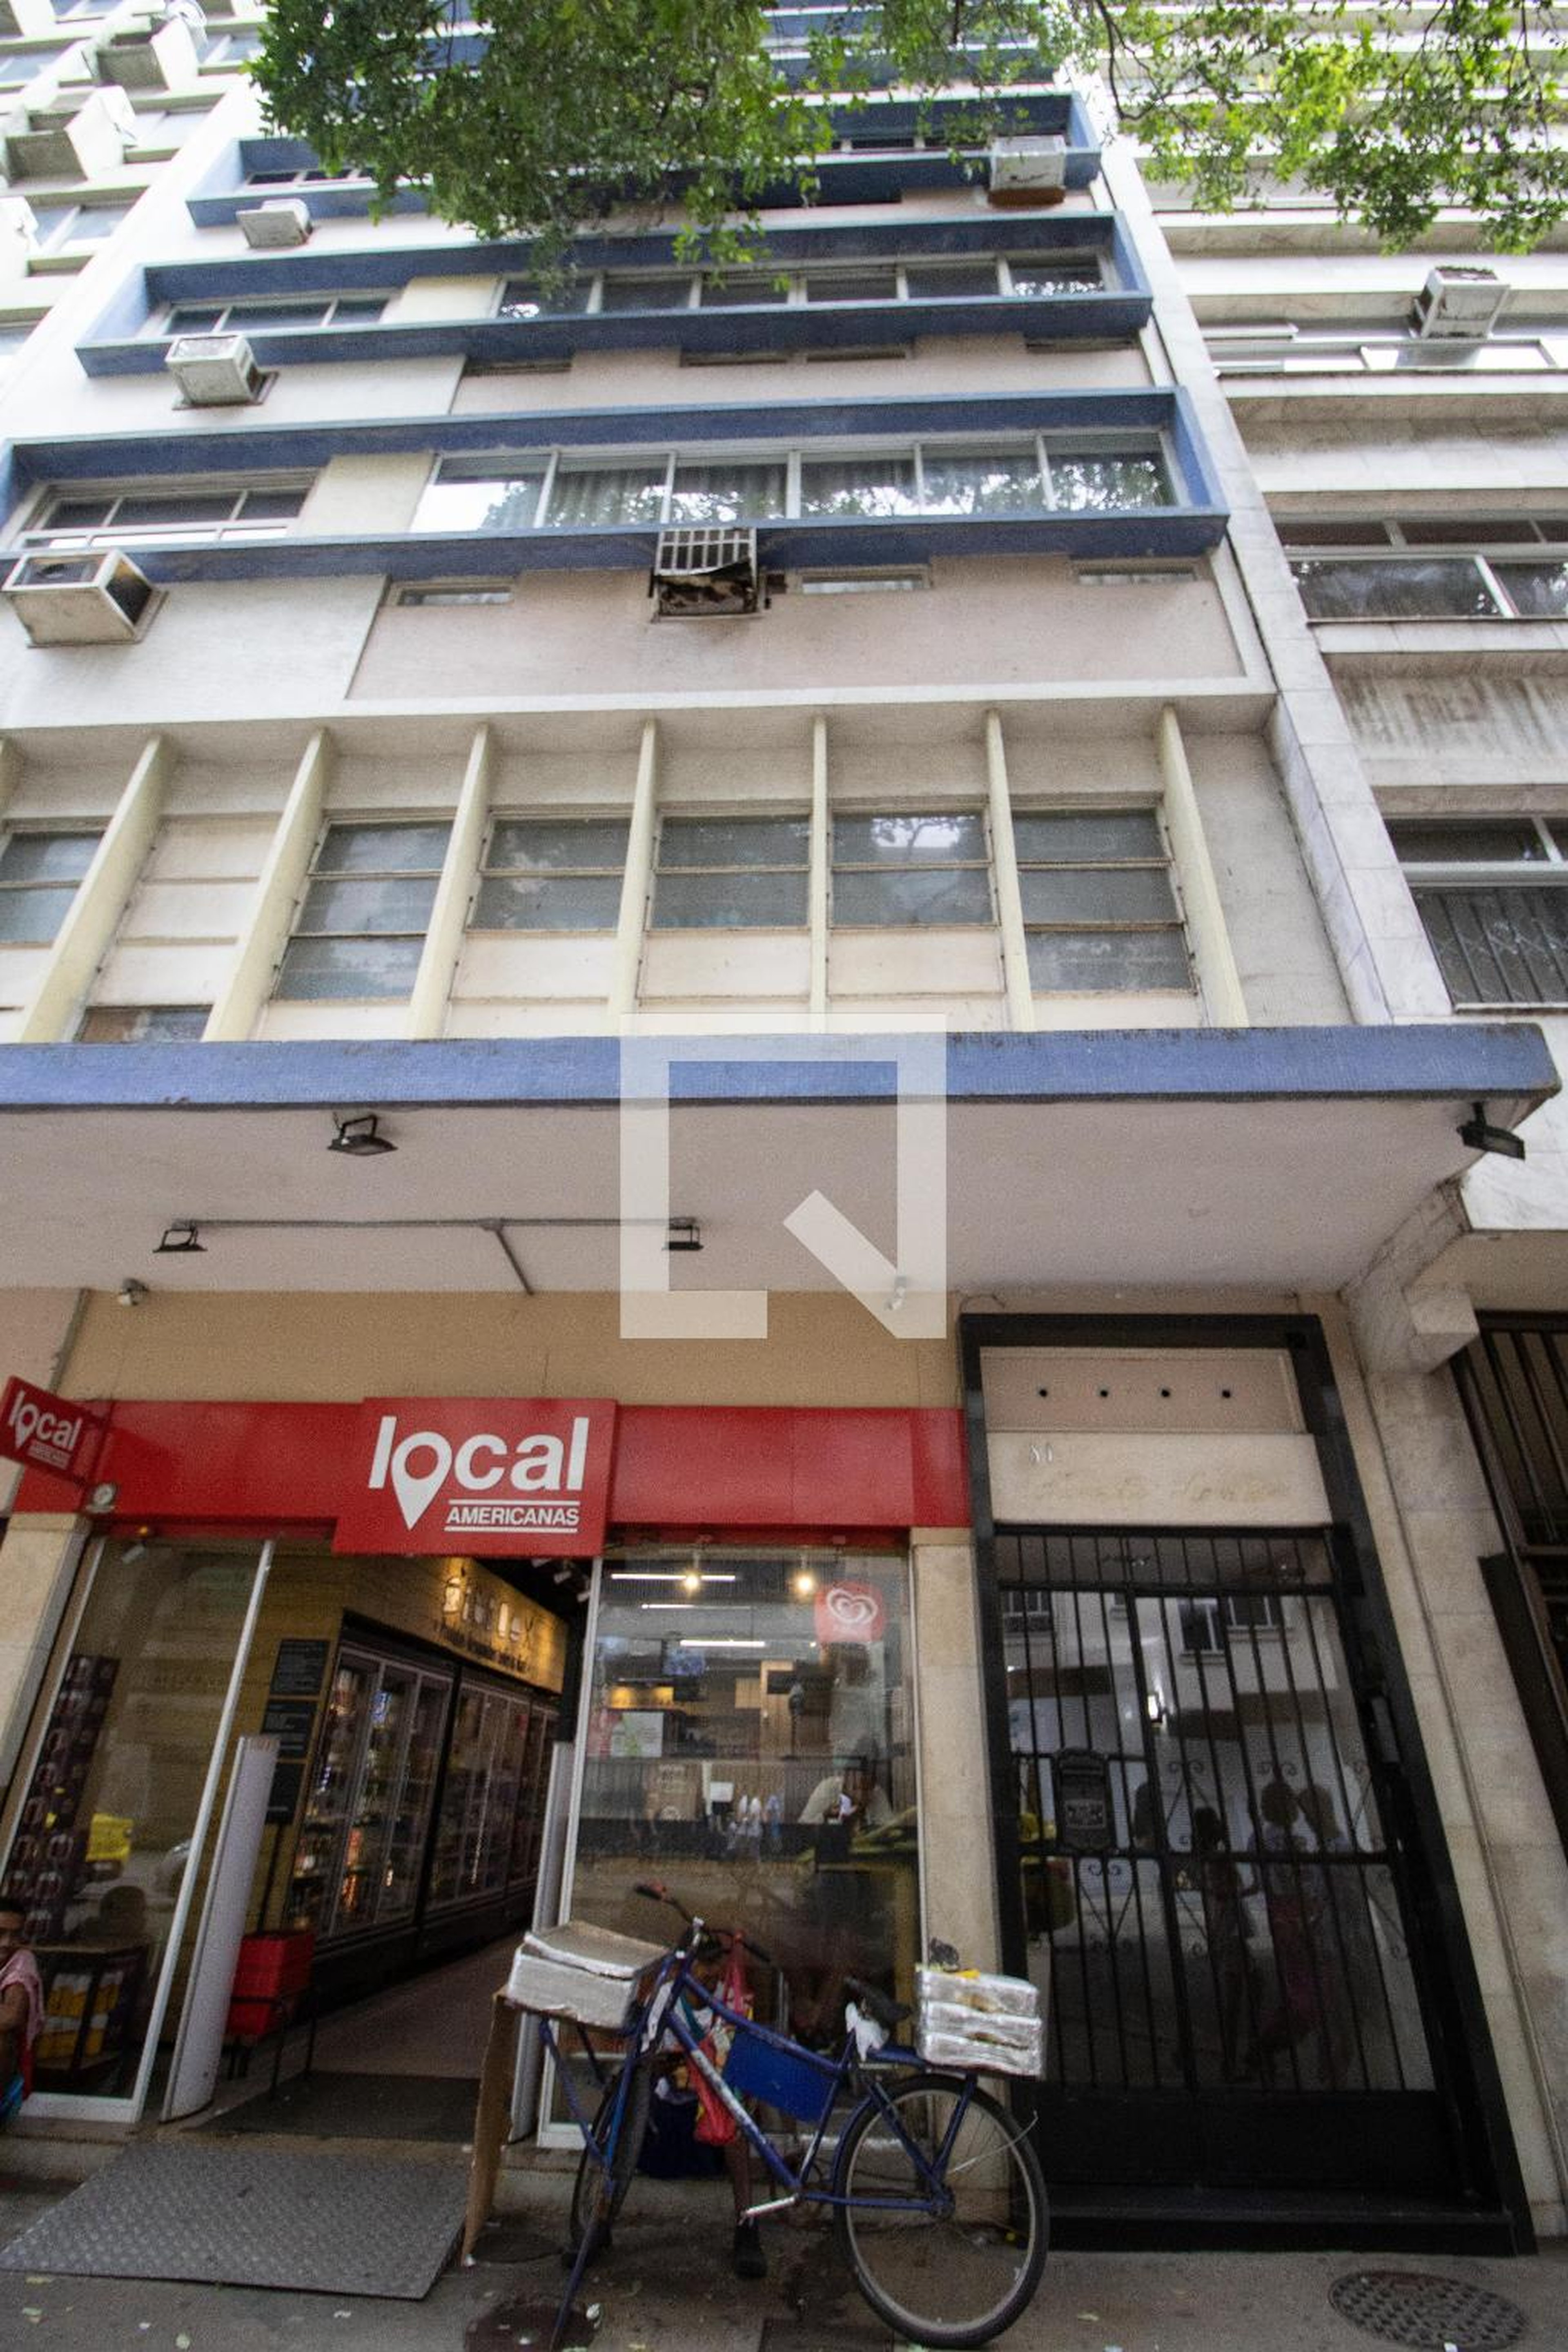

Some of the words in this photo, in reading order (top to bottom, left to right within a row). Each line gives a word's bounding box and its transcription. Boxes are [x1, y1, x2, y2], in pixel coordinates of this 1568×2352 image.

[8, 1390, 83, 1450] local
[368, 1415, 589, 1530] local
[445, 1506, 580, 1526] AMERICANAS
